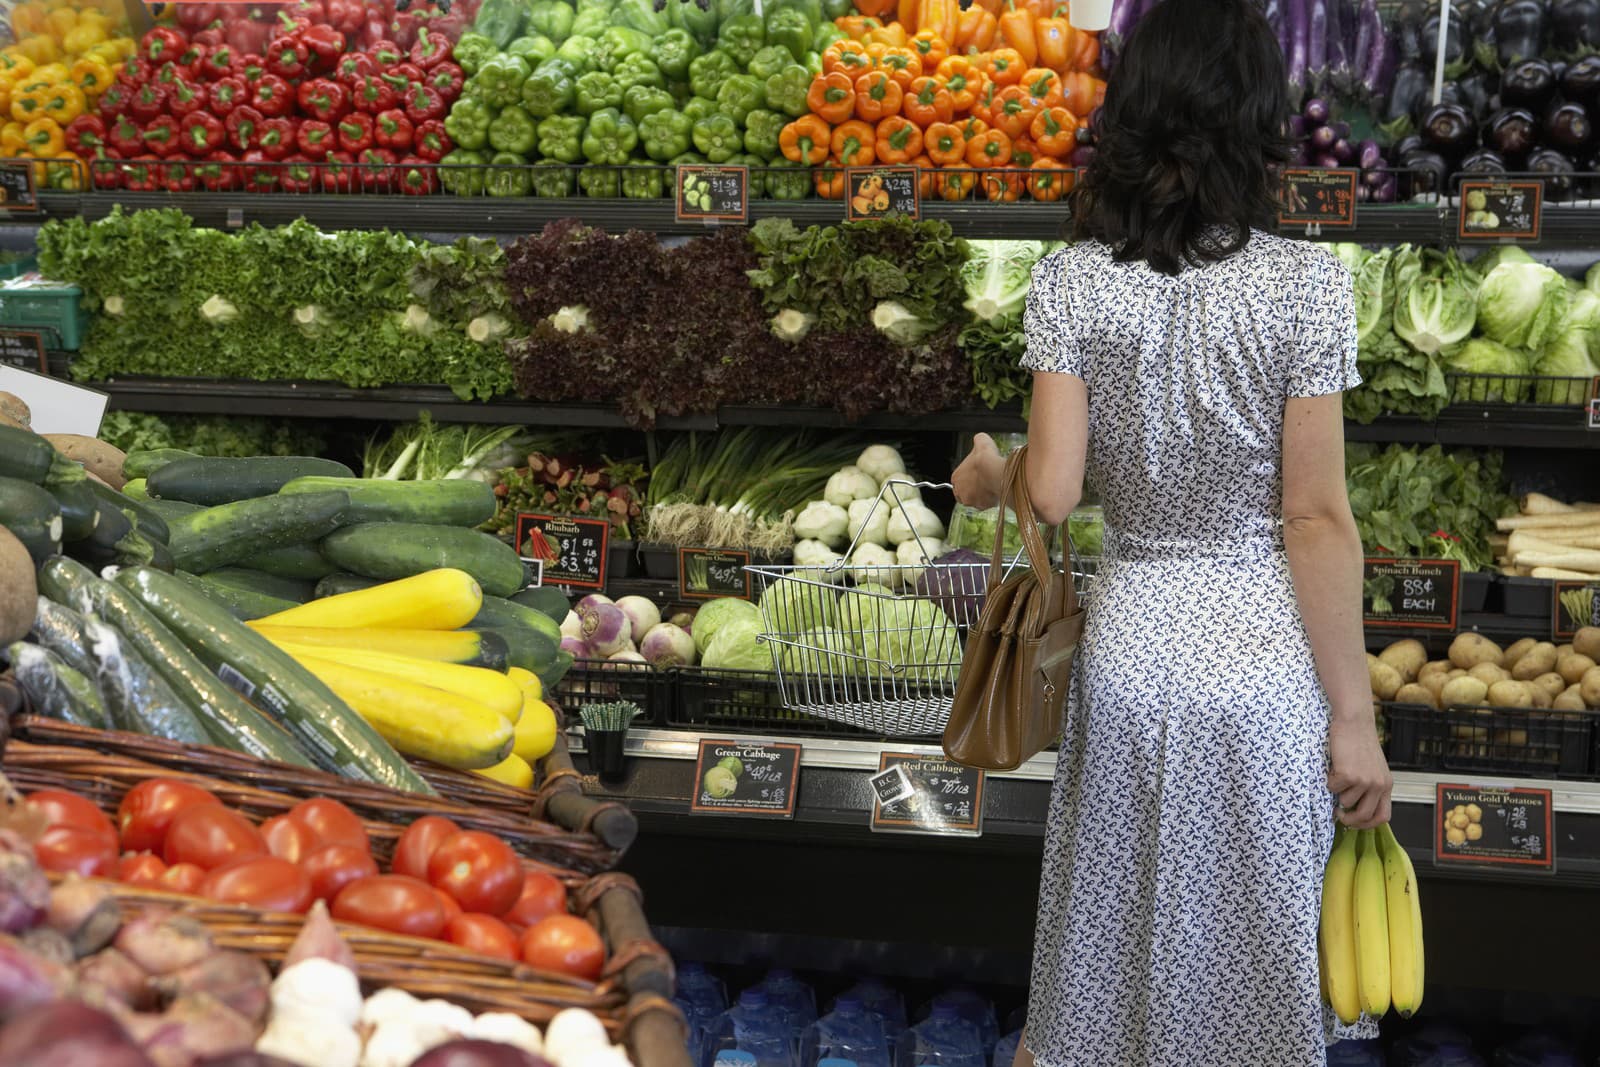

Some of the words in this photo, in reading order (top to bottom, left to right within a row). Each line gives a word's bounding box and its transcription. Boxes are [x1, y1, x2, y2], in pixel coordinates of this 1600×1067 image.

[545, 522, 580, 534] Rhubarb
[1372, 565, 1409, 577] Spinach
[1411, 566, 1442, 576] Bunch
[1403, 578, 1434, 597] 88¢
[1403, 598, 1436, 611] EACH
[715, 747, 741, 757] Green
[743, 749, 781, 761] Cabbage
[902, 761, 921, 771] Red
[923, 763, 964, 774] Cabbage
[1446, 791, 1477, 801] Yukon
[1478, 794, 1502, 804] Gold
[1503, 795, 1543, 806] Potatoes
